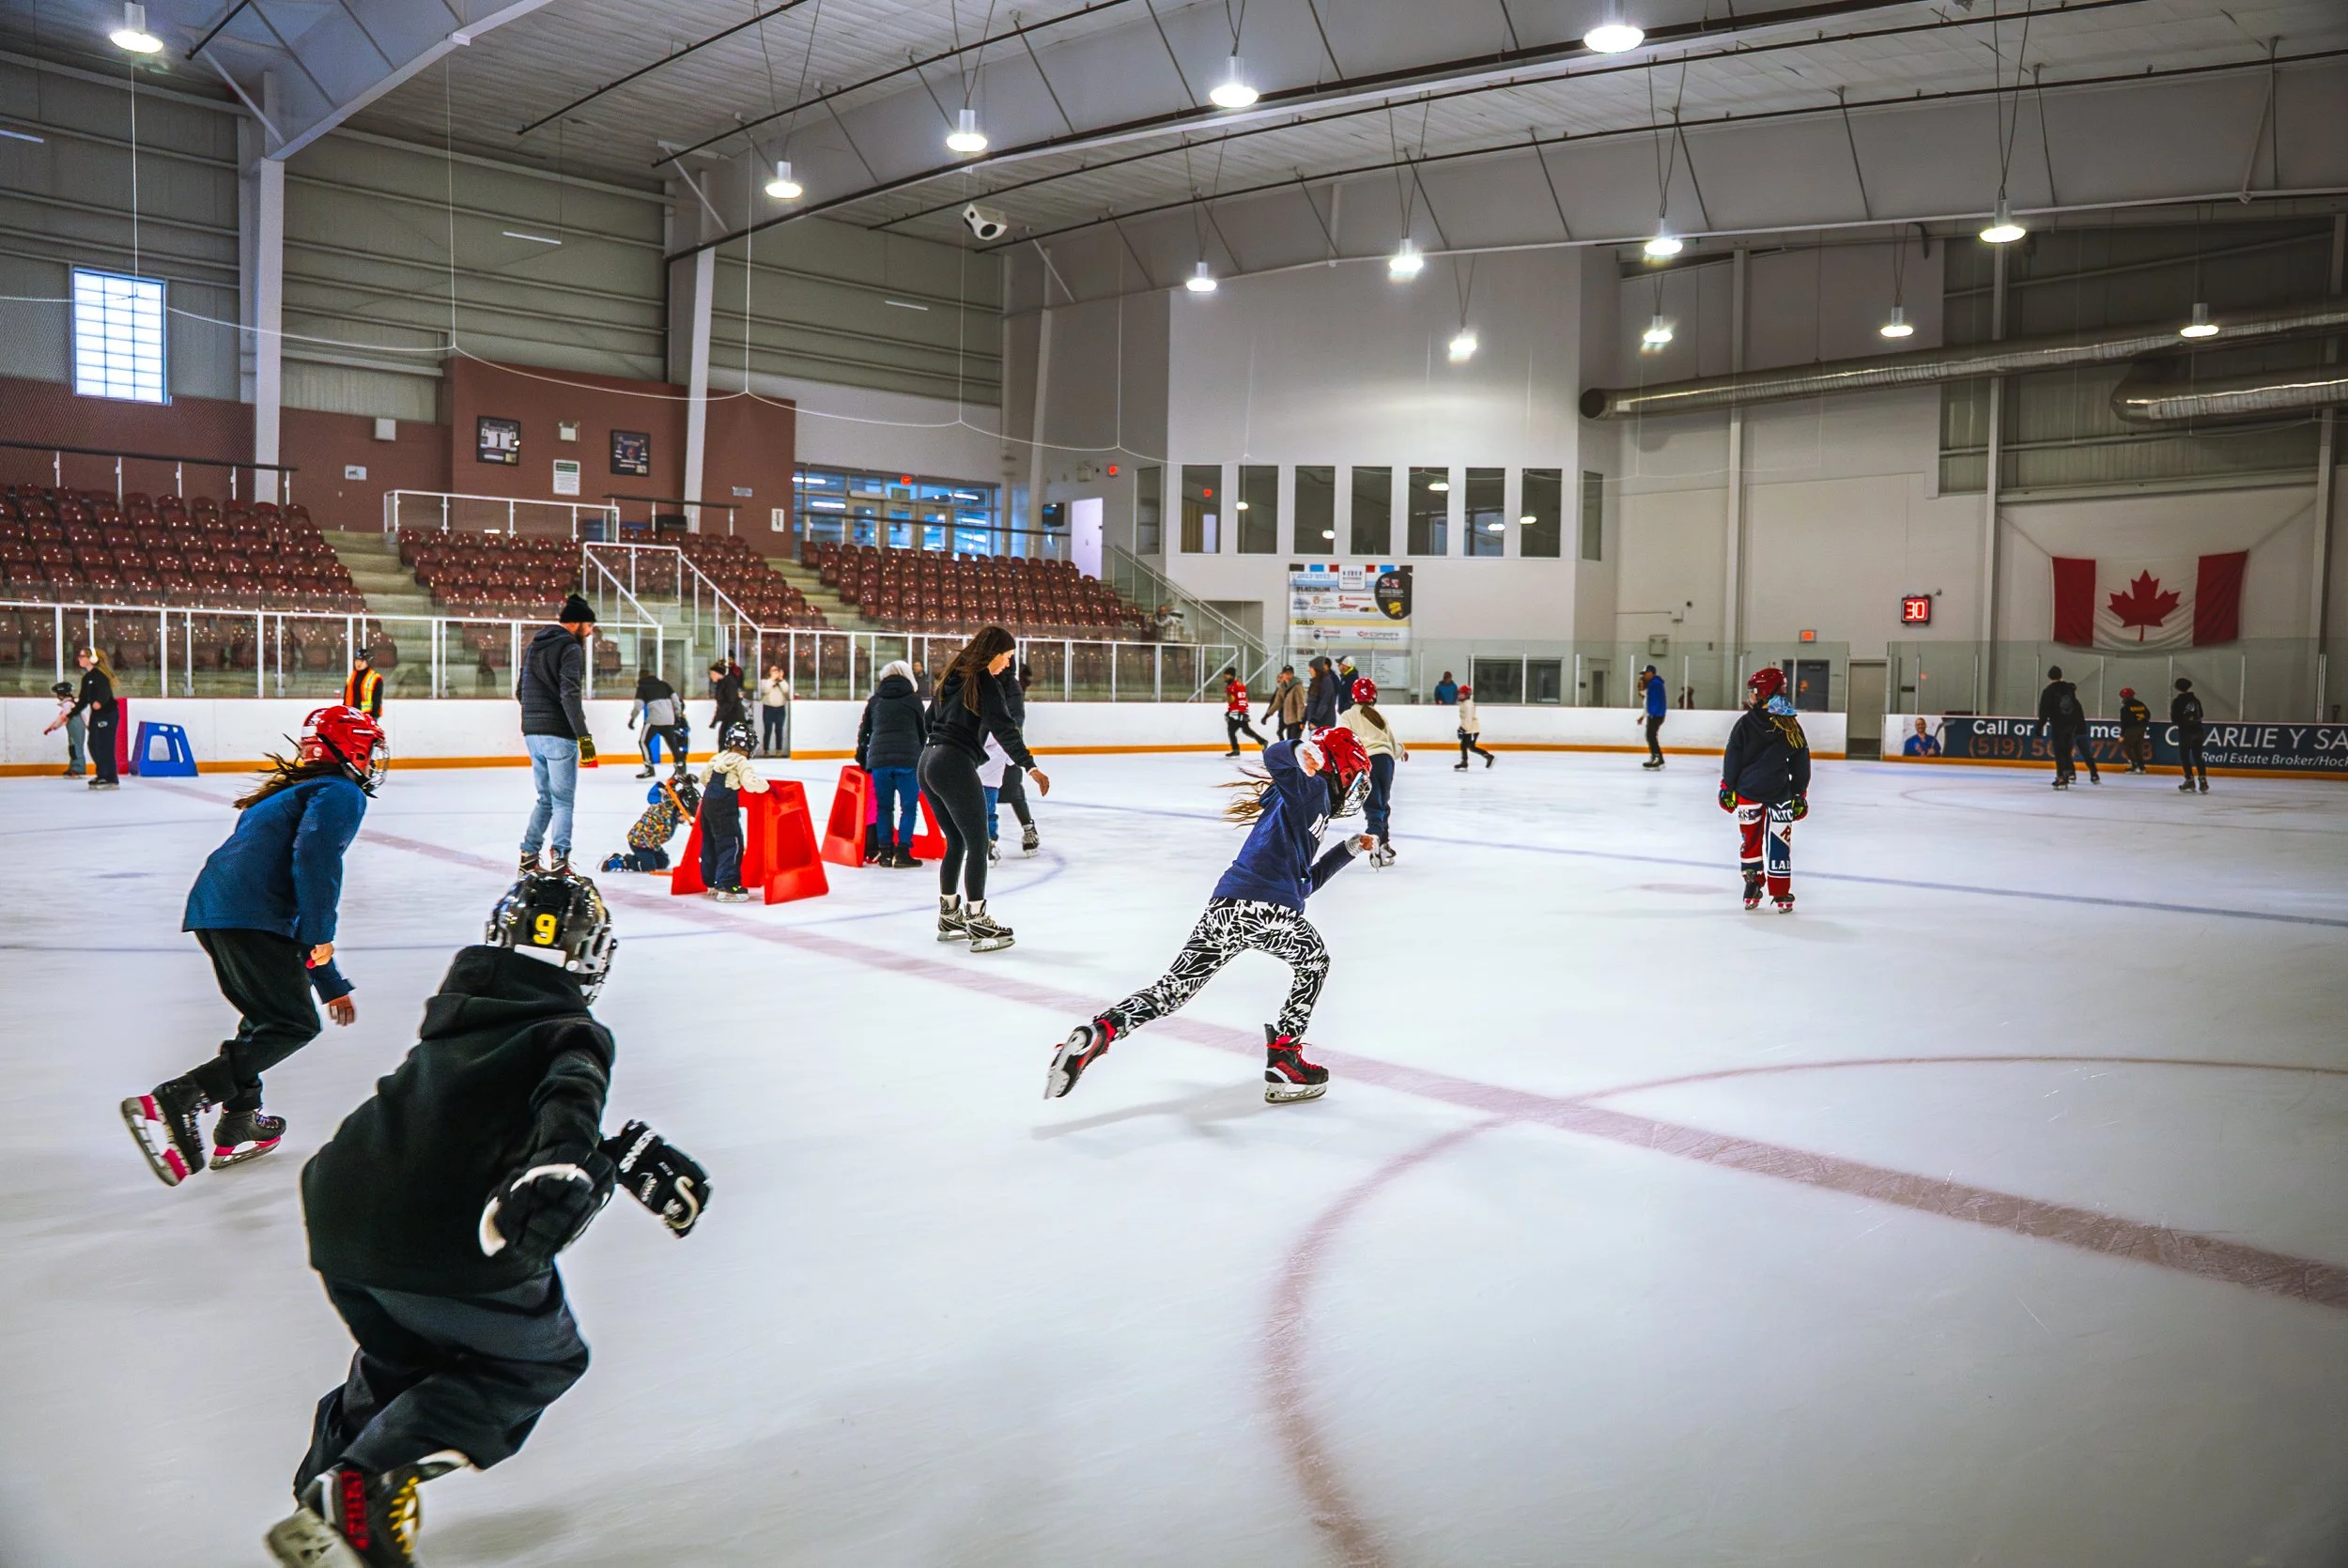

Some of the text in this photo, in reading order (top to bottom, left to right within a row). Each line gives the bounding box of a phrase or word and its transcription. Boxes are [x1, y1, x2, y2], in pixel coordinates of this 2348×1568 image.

[1906, 601, 1925, 619] 30
[1972, 720, 2008, 735] Call
[2014, 725, 2033, 736] or
[2090, 726, 2122, 738] me
[2165, 725, 2279, 748] CARLIE
[2289, 729, 2307, 749] Y
[1969, 736, 2023, 759] (519)
[2202, 752, 2228, 763] Real
[2230, 753, 2269, 764] Estate
[533, 914, 557, 945] 9
